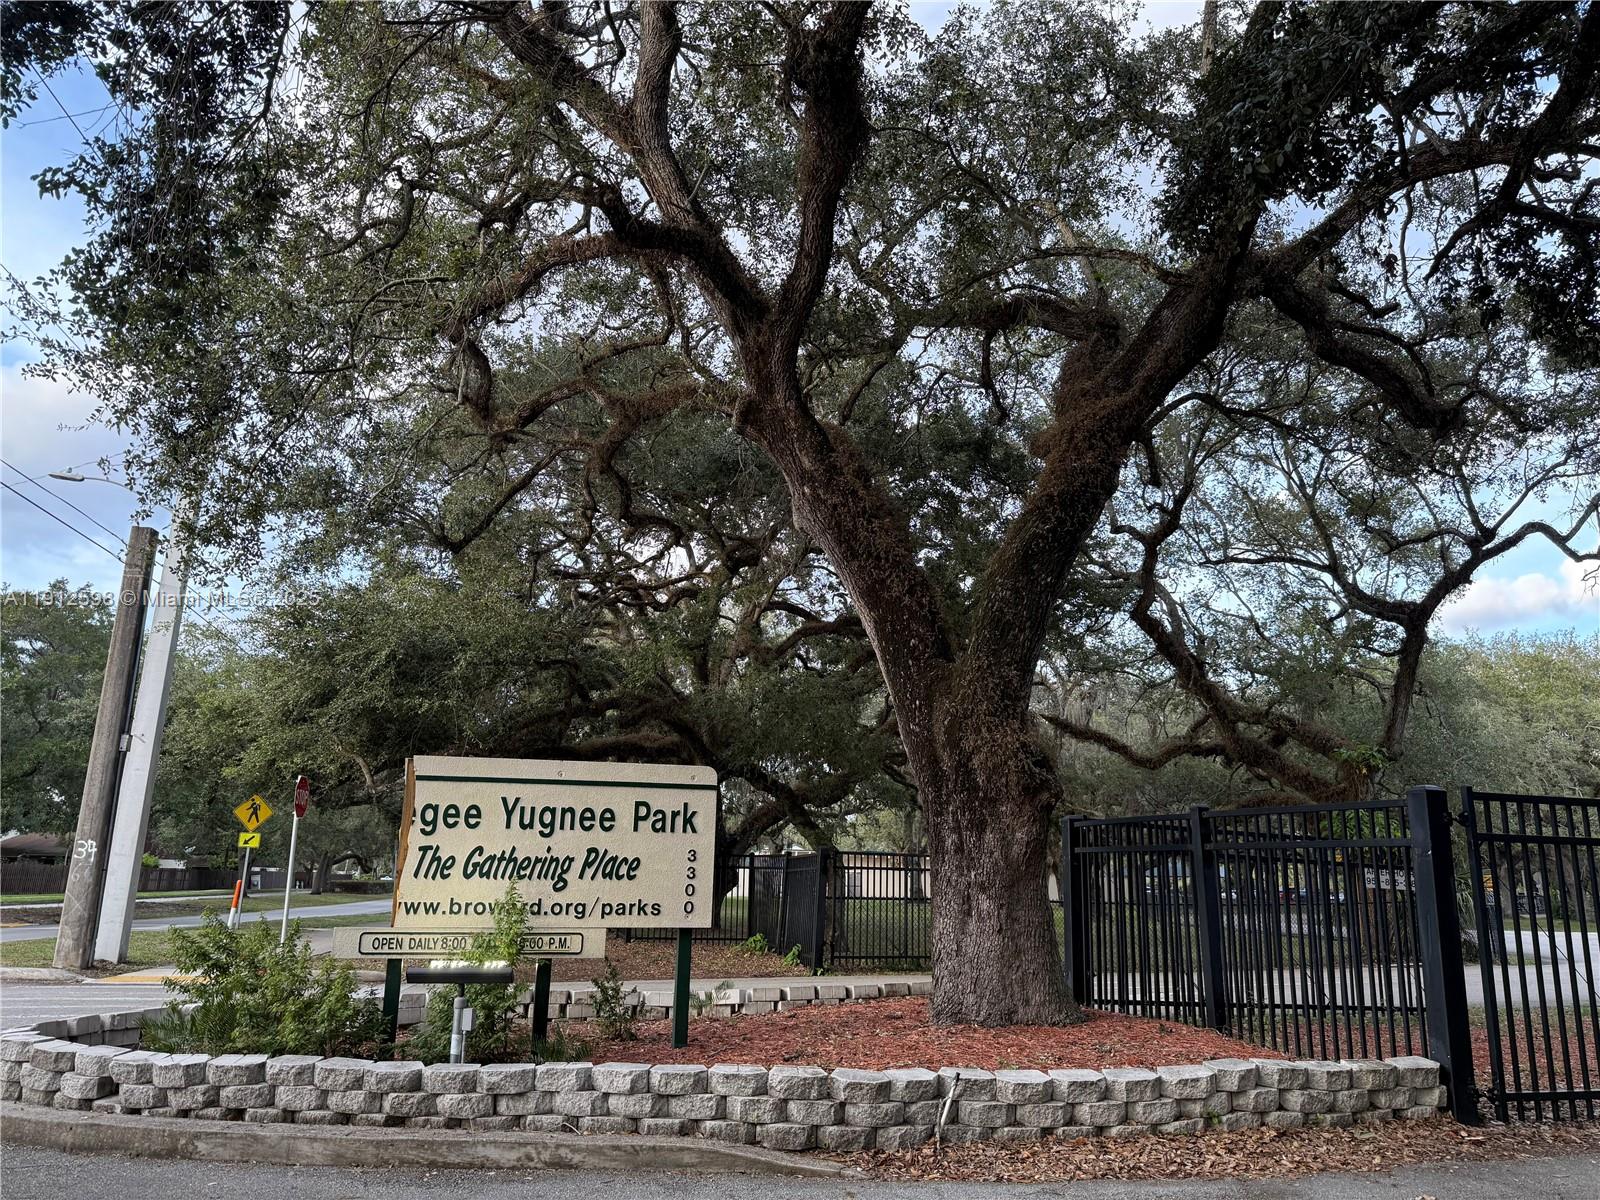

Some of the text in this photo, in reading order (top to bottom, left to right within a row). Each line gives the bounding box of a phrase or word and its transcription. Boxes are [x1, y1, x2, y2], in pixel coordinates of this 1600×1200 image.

[411, 797, 698, 838] gee Yugnee Park
[413, 844, 641, 893] The Gathering Place
[683, 849, 697, 914] 3300
[372, 937, 403, 950] OPEN
[409, 937, 439, 950] DAILY
[441, 937, 467, 950] 8:00
[548, 937, 570, 950] P.M.
